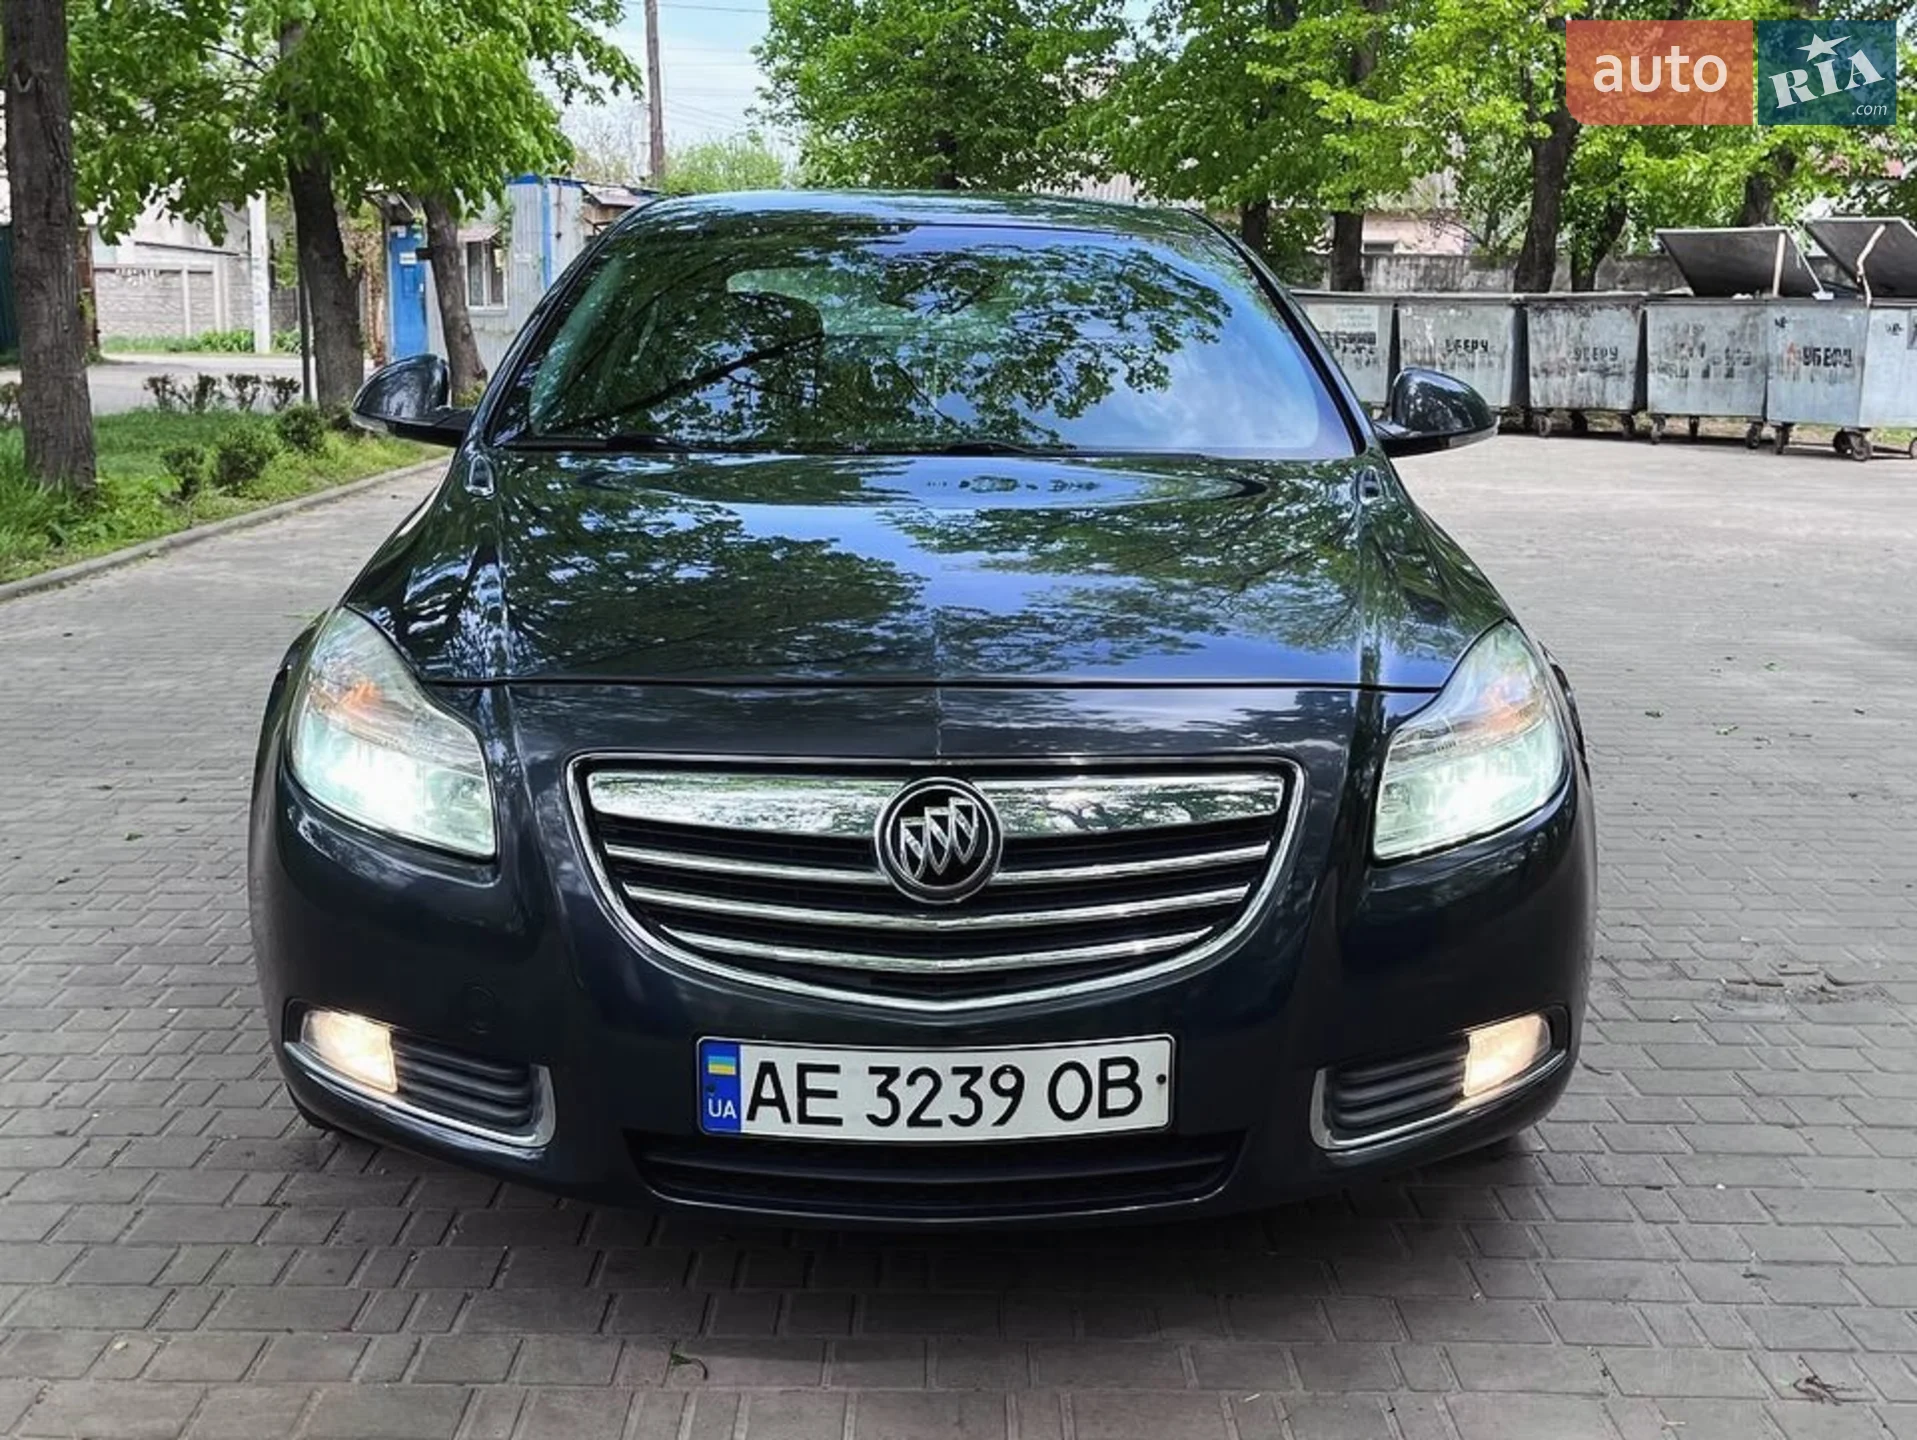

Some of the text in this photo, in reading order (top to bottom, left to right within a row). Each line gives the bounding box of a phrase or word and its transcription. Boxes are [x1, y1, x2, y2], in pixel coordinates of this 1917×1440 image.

[707, 1098, 737, 1120] UA
[745, 1056, 1143, 1128] AE 3239 OB
